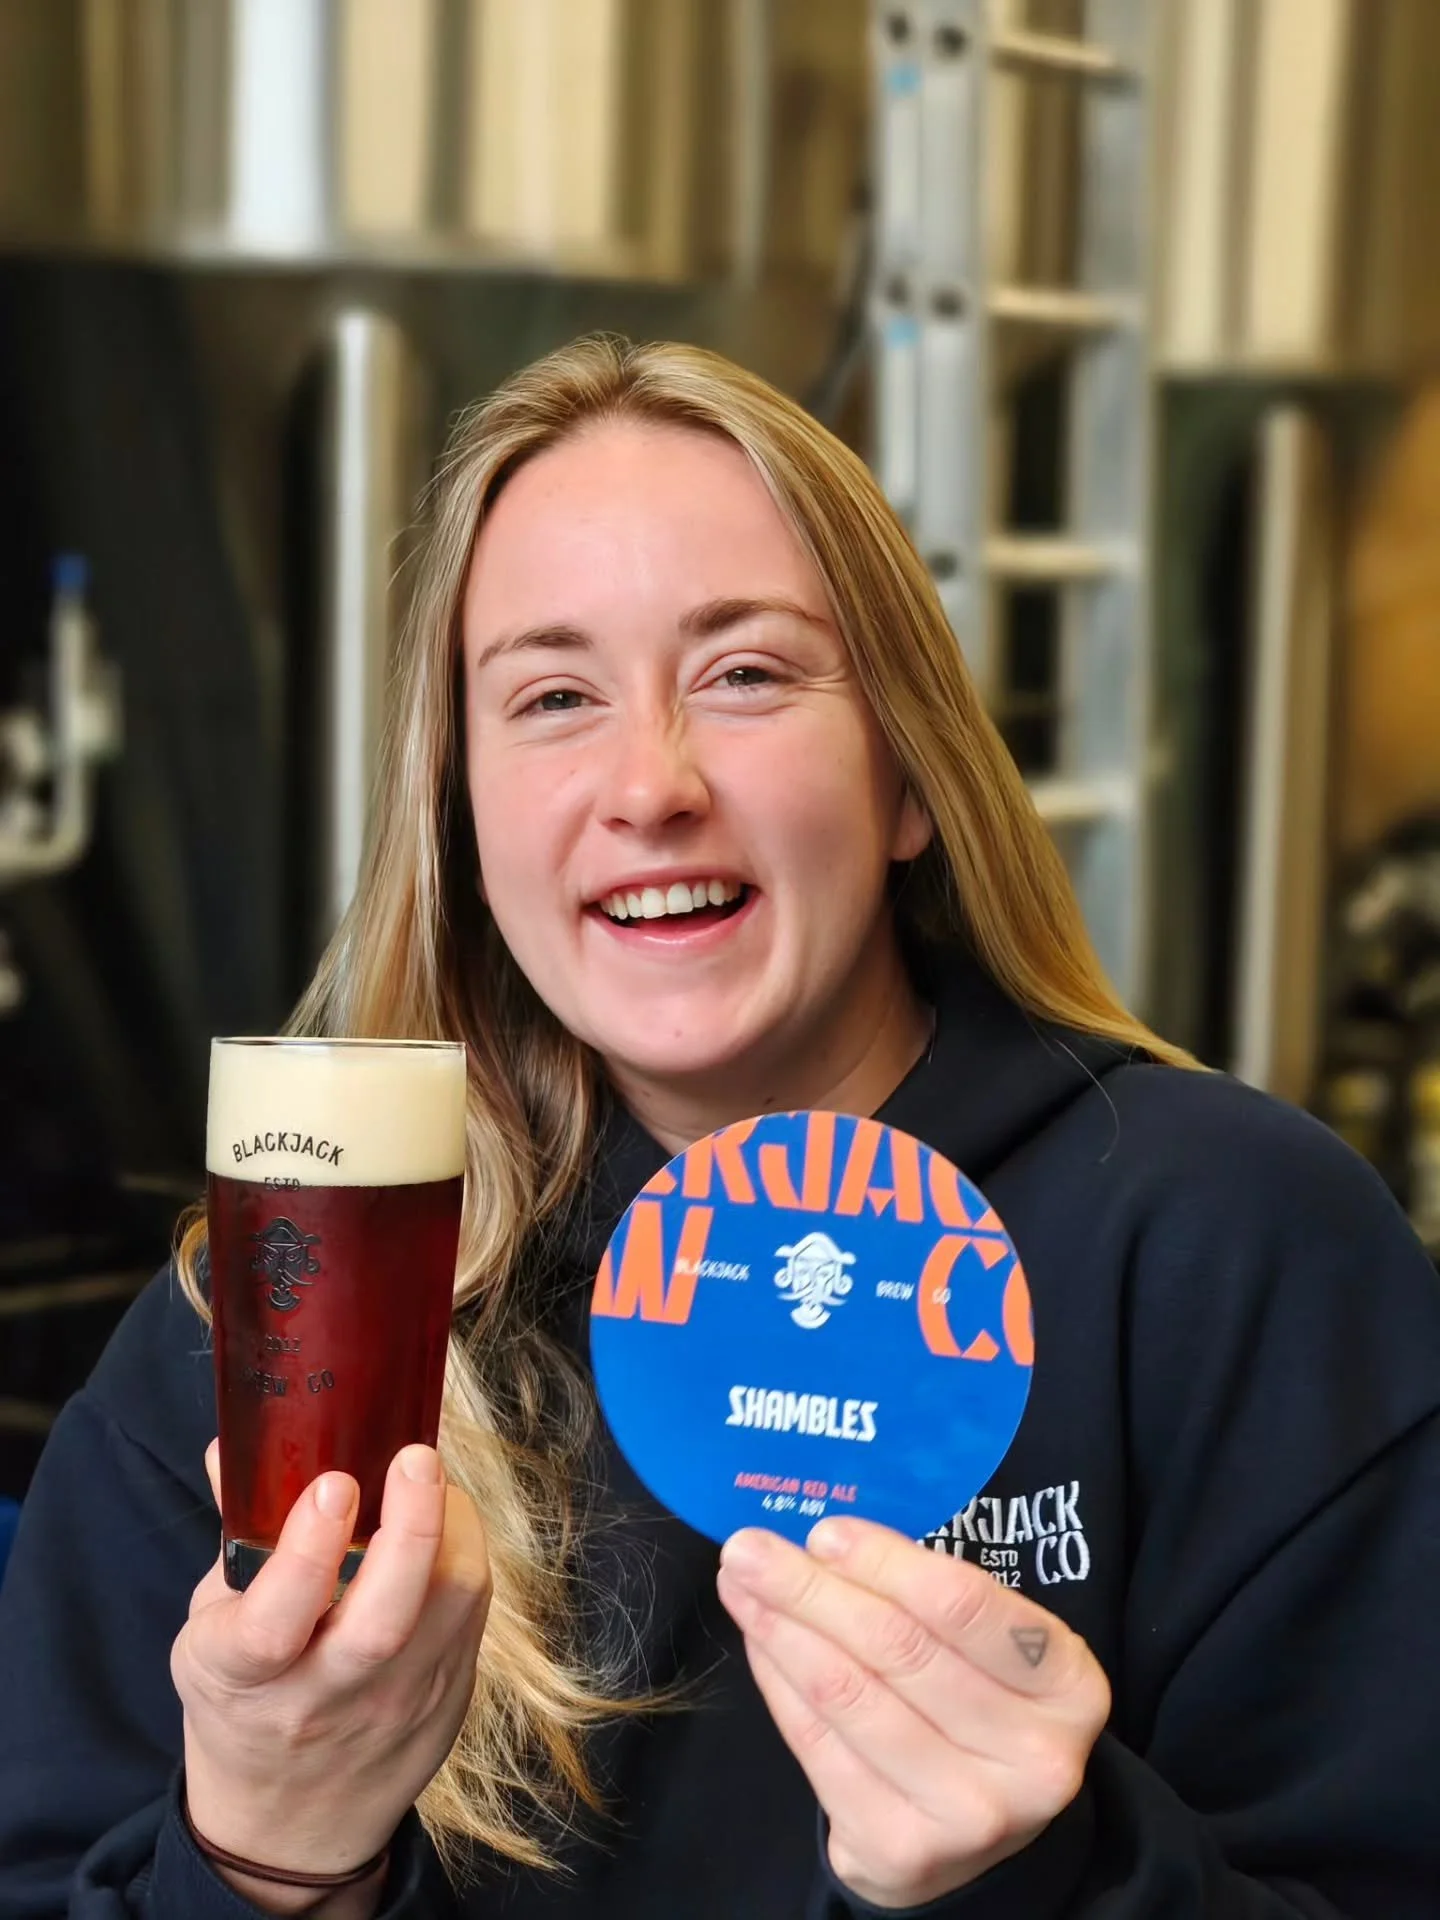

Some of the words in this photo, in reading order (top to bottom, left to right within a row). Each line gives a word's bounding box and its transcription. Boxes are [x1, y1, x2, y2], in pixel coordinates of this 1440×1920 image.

[231, 1131, 345, 1167] BLACKJACK
[264, 1176, 302, 1193] ESTD
[674, 1258, 751, 1282] BLACKJACK
[876, 1280, 915, 1301] BREW
[932, 1287, 952, 1305] CO
[307, 1367, 335, 1394] CO
[725, 1384, 878, 1443] SHAMBLES
[734, 1471, 800, 1494] AMERICAN
[802, 1479, 828, 1499] RED
[830, 1483, 858, 1503] ALE
[798, 1498, 827, 1517] ABV
[980, 1548, 1019, 1567] ESTD
[1035, 1530, 1091, 1585] CO
[991, 1570, 1021, 1587] 012
